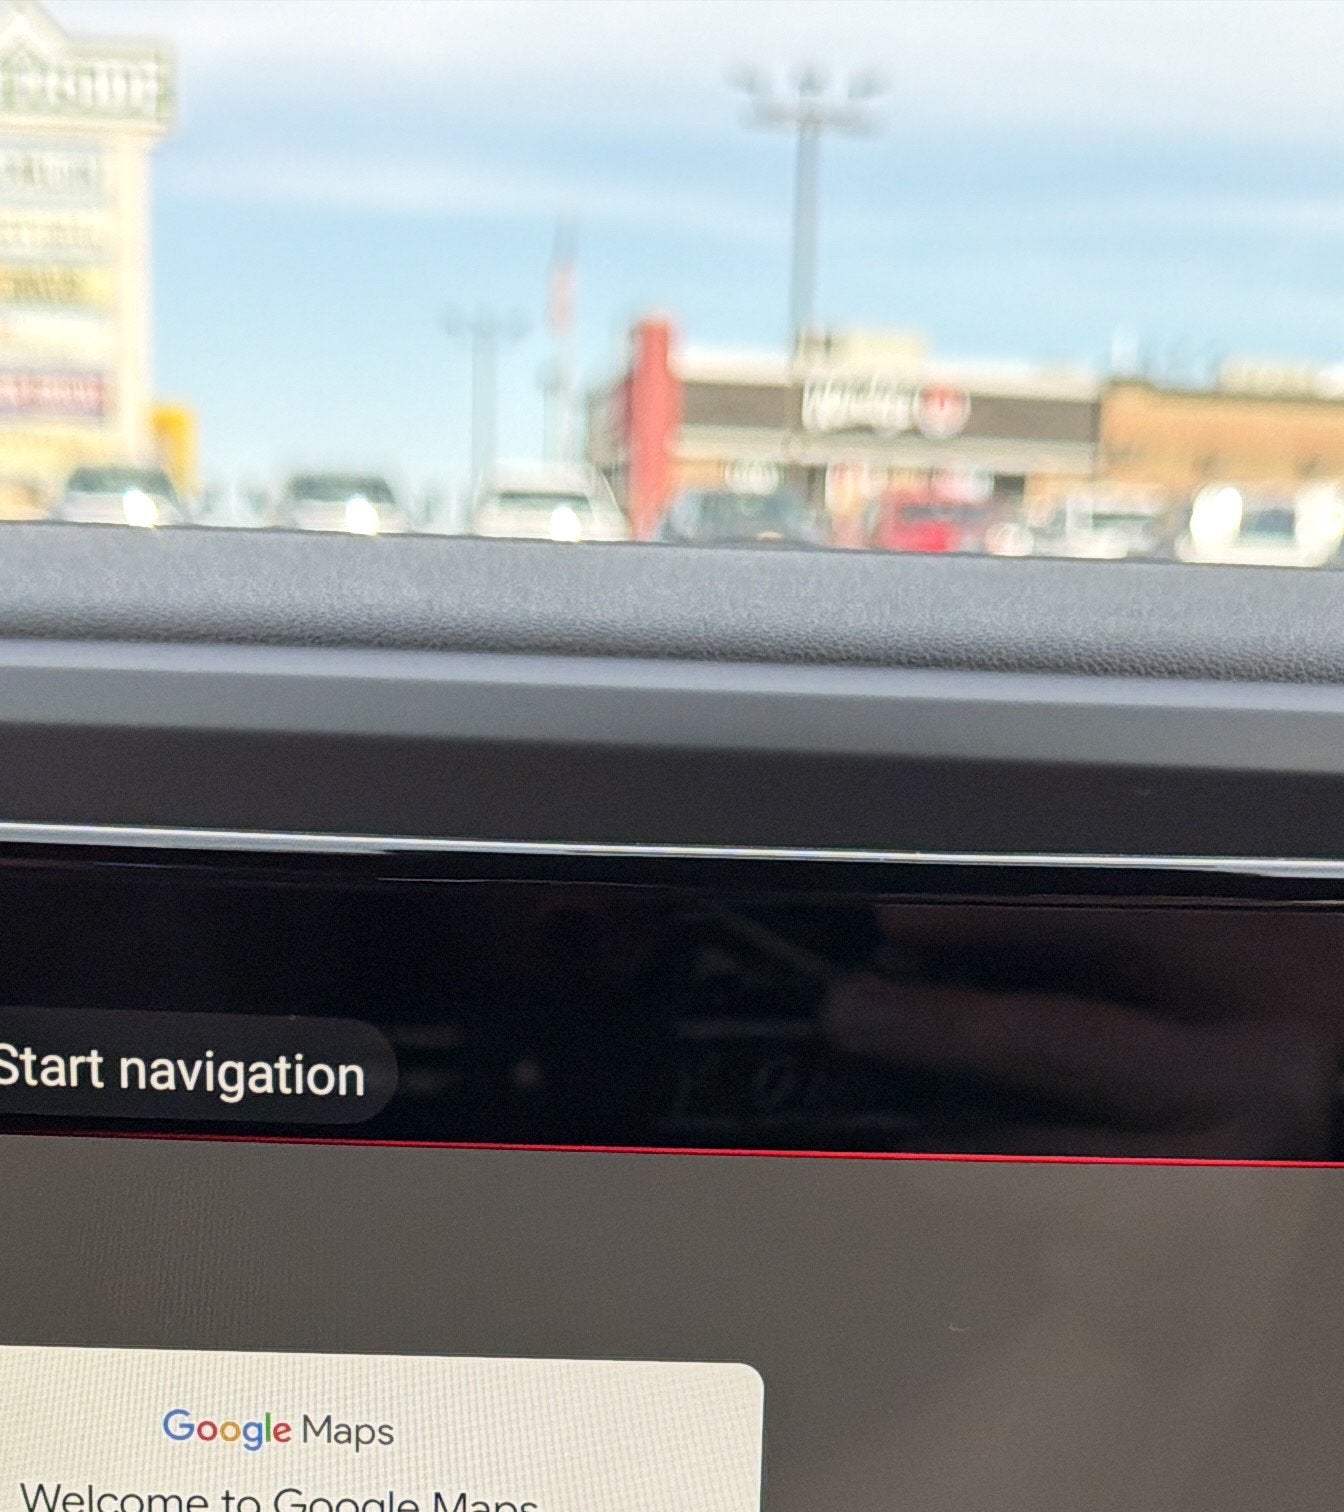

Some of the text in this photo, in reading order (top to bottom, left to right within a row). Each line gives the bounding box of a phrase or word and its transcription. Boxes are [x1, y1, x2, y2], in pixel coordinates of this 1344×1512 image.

[120, 1049, 365, 1104] navigation
[162, 1408, 395, 1453] Google Maps
